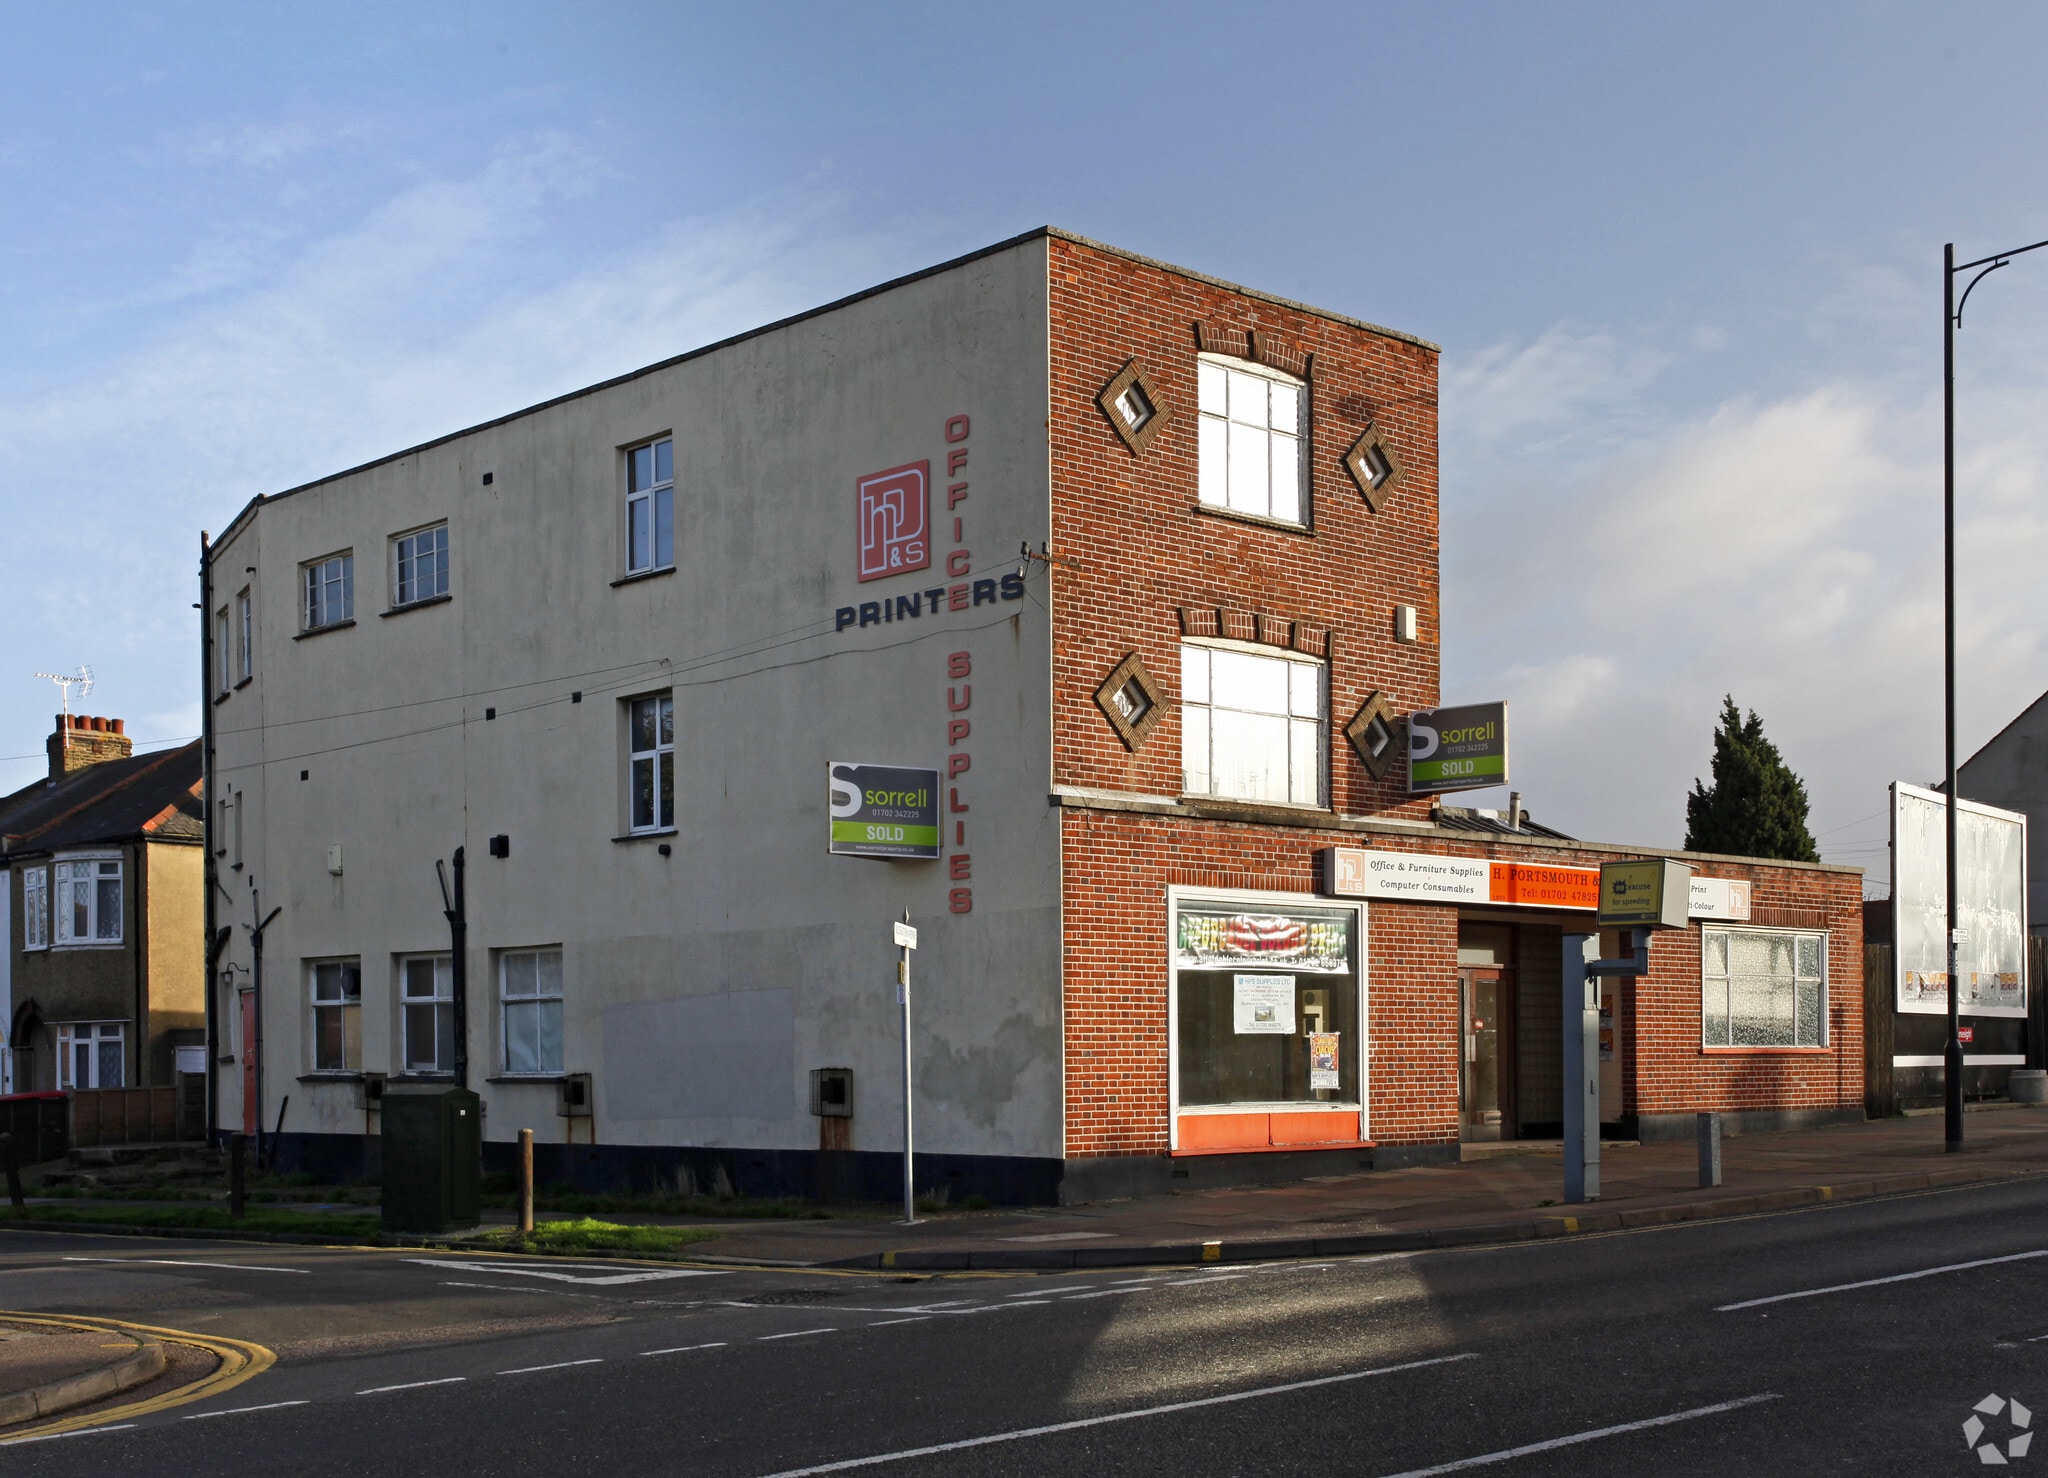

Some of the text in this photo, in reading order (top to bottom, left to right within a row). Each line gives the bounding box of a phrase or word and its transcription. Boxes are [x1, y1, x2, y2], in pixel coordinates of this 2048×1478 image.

[944, 414, 969, 612] OFFICE
[835, 573, 1024, 632] PRINTERS
[1441, 721, 1495, 744] sorrell
[1447, 746, 1466, 754] 01702
[1441, 760, 1474, 776] SOLD
[947, 651, 972, 914] SUPPLIES
[865, 788, 927, 808] sorrell
[872, 808, 920, 819] 01702 342225
[867, 825, 904, 841] SOLD
[1370, 860, 1483, 878] Office & Furniture Supplies
[1493, 868, 1505, 880] H.
[1510, 868, 1588, 886] PORTSMOUTH
[1380, 879, 1474, 894] Computer Consumables
[1627, 883, 1651, 891] excuse
[1690, 885, 1707, 893] Print
[1521, 888, 1598, 902] Tel: 01702 47825
[1612, 897, 1650, 907] for speeding
